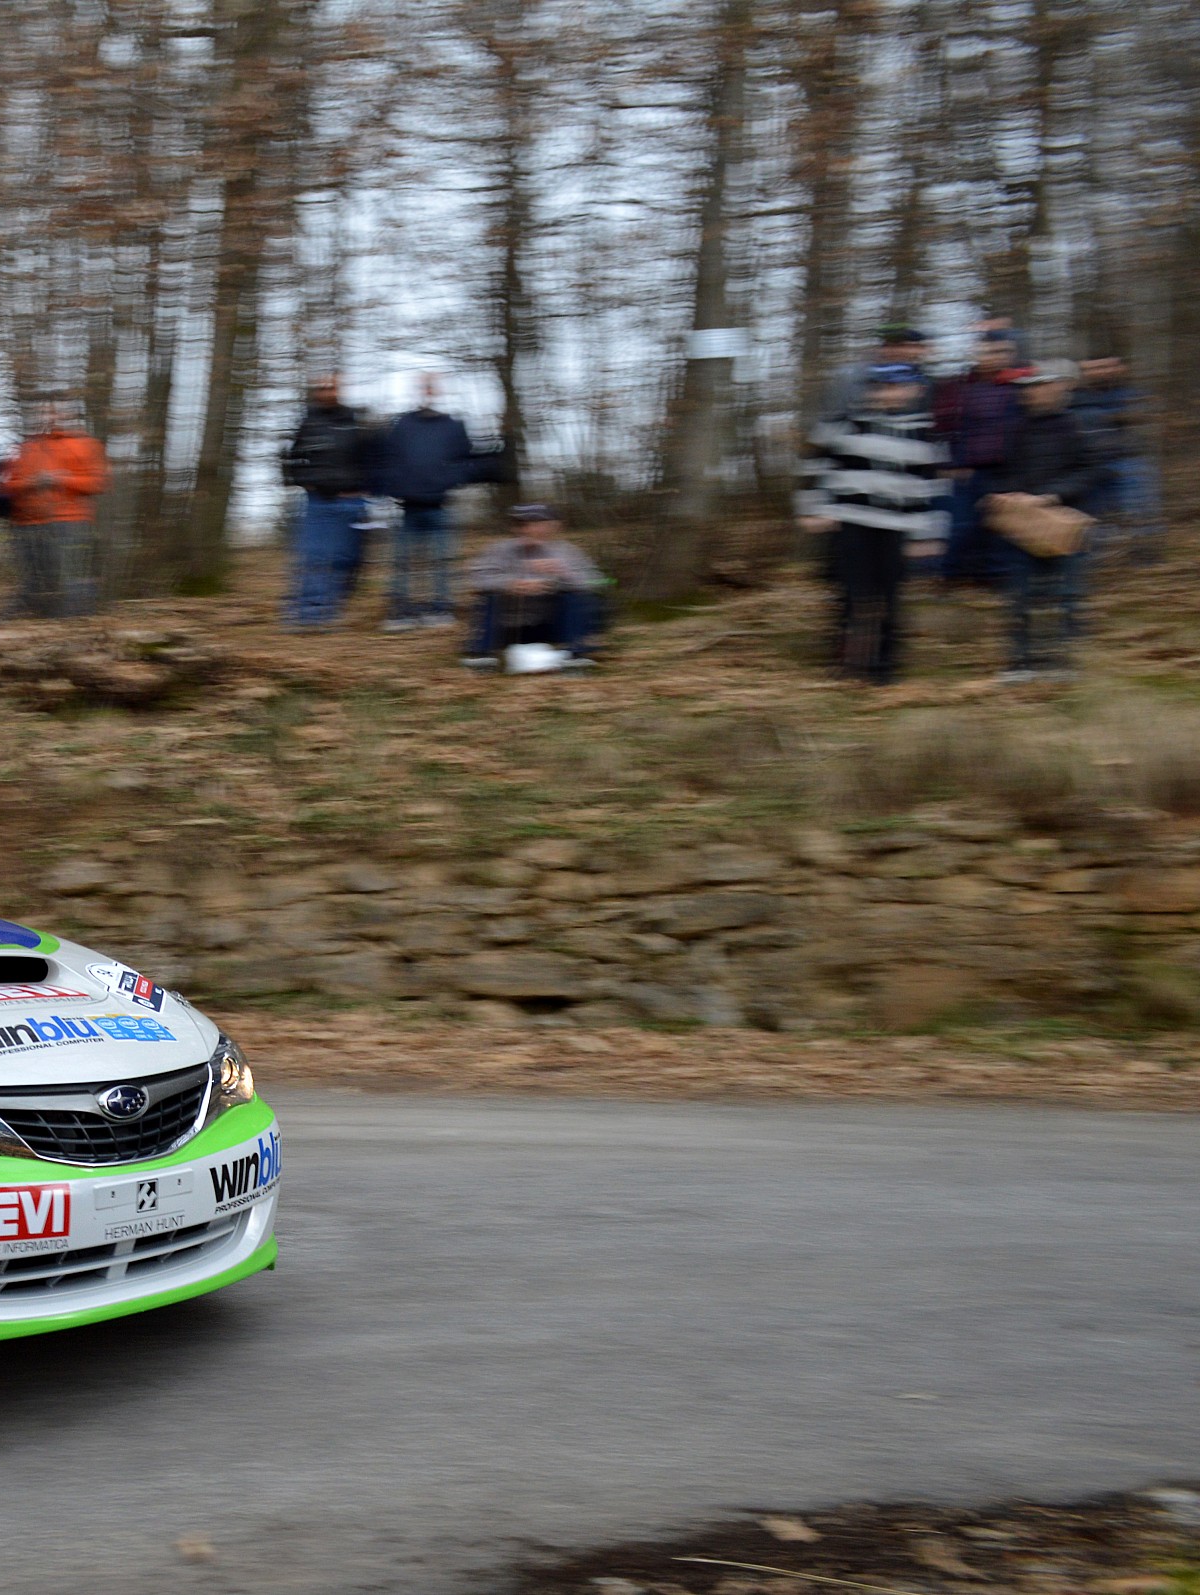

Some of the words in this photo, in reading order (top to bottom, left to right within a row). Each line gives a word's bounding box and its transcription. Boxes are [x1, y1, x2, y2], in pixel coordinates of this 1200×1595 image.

[56, 1037, 105, 1047] COMPUTER
[209, 1132, 282, 1203] winblu
[104, 1220, 154, 1241] HERMAN
[156, 1215, 185, 1231] HUNT
[4, 1239, 69, 1254] INFORMATICA
